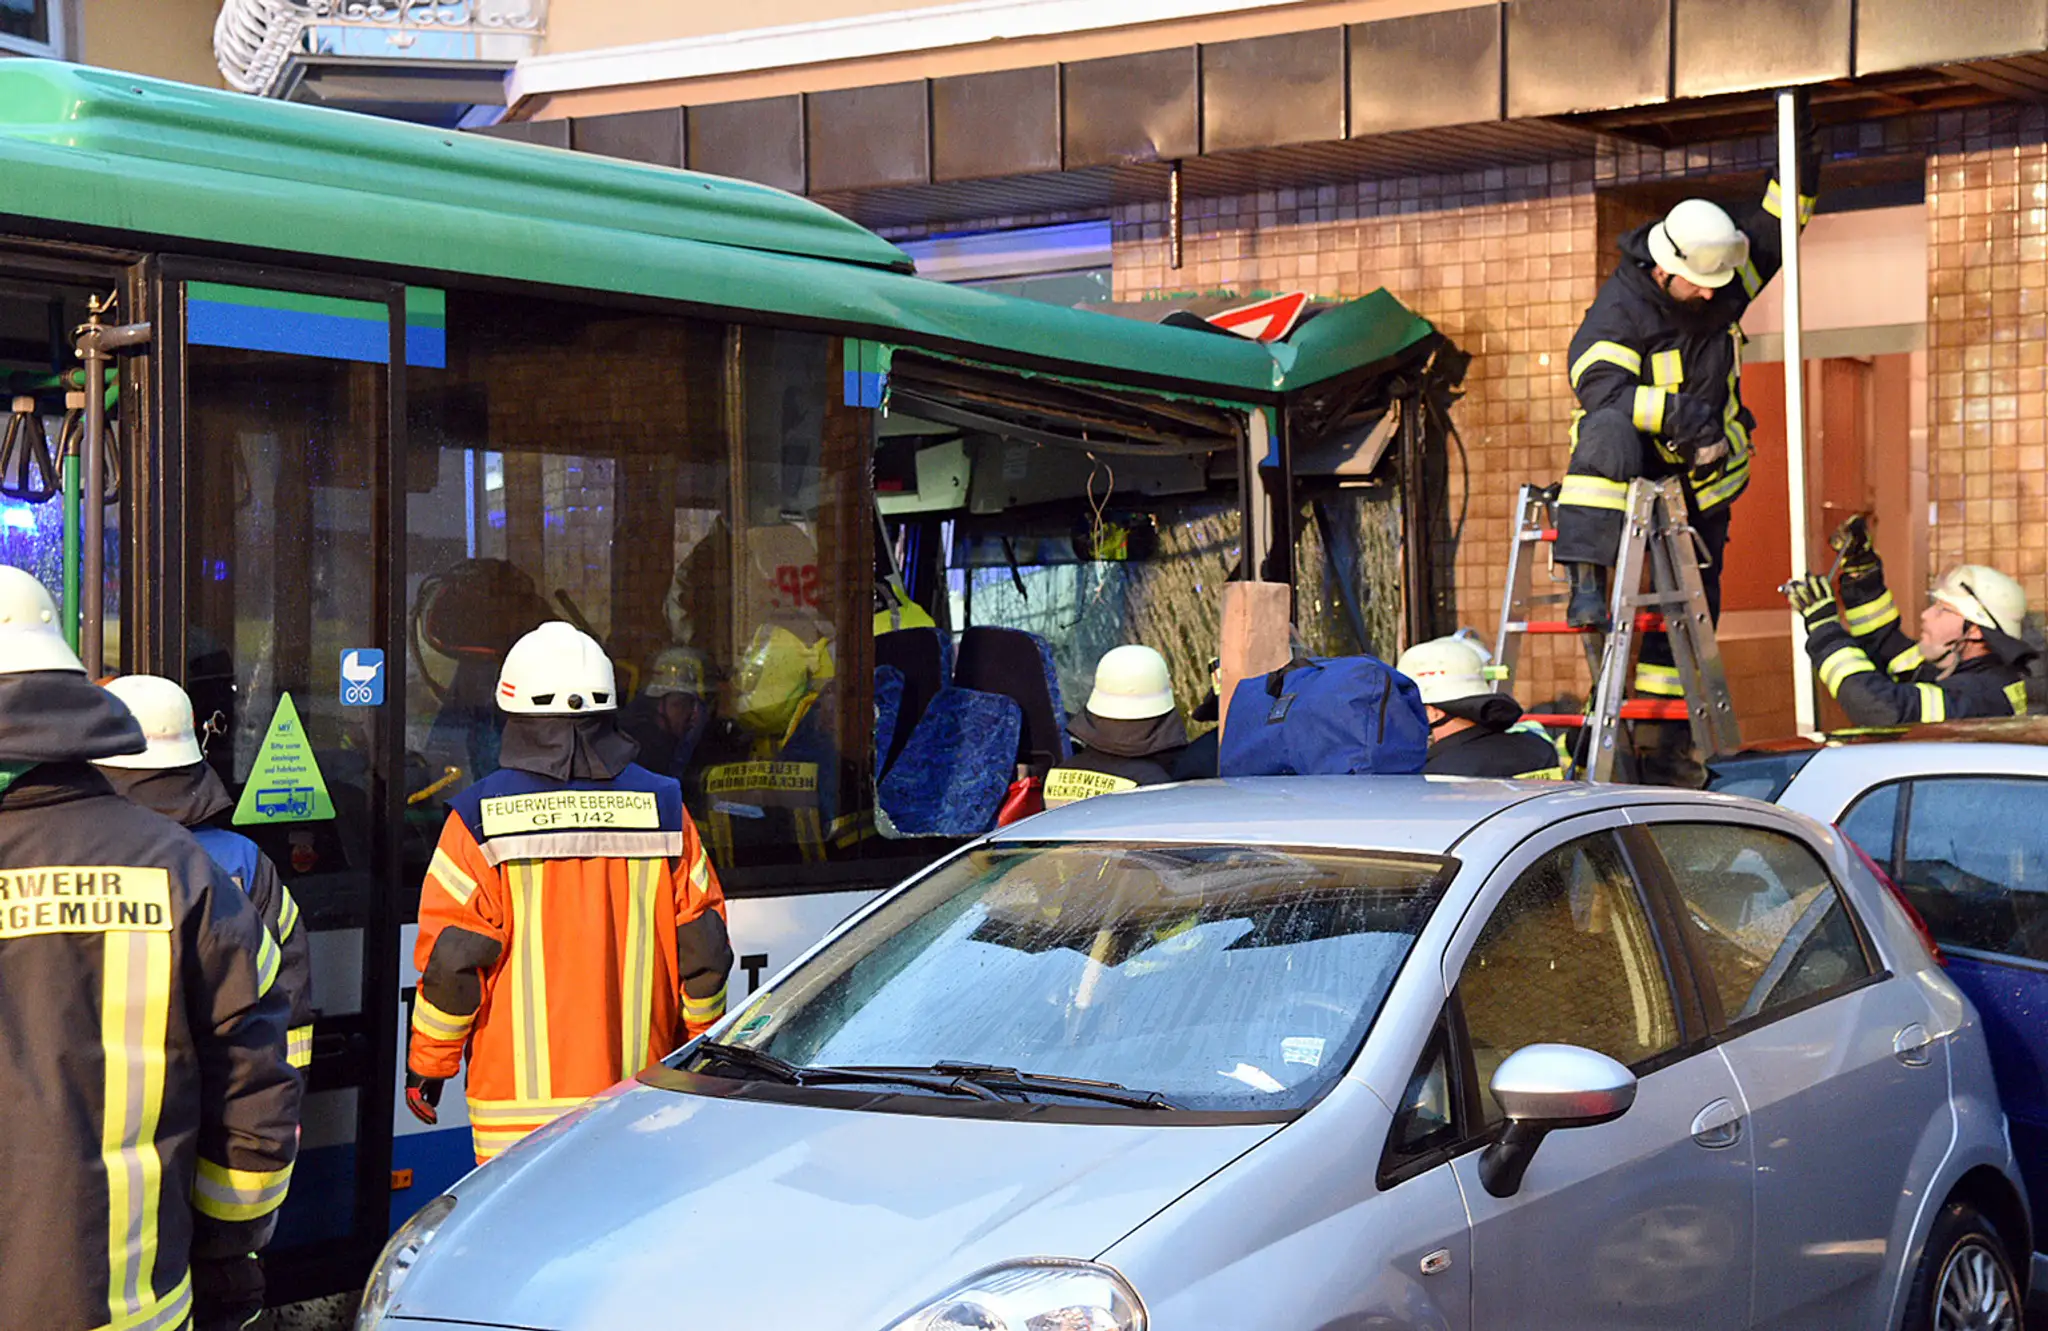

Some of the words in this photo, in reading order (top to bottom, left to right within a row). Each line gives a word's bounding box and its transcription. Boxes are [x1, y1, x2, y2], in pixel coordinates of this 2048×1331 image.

[486, 795, 577, 817] FEUERWEHR
[579, 795, 652, 811] EBERBACH
[532, 811, 563, 826] GF
[571, 811, 616, 825] 1/42
[0, 897, 163, 930] GEMÜND
